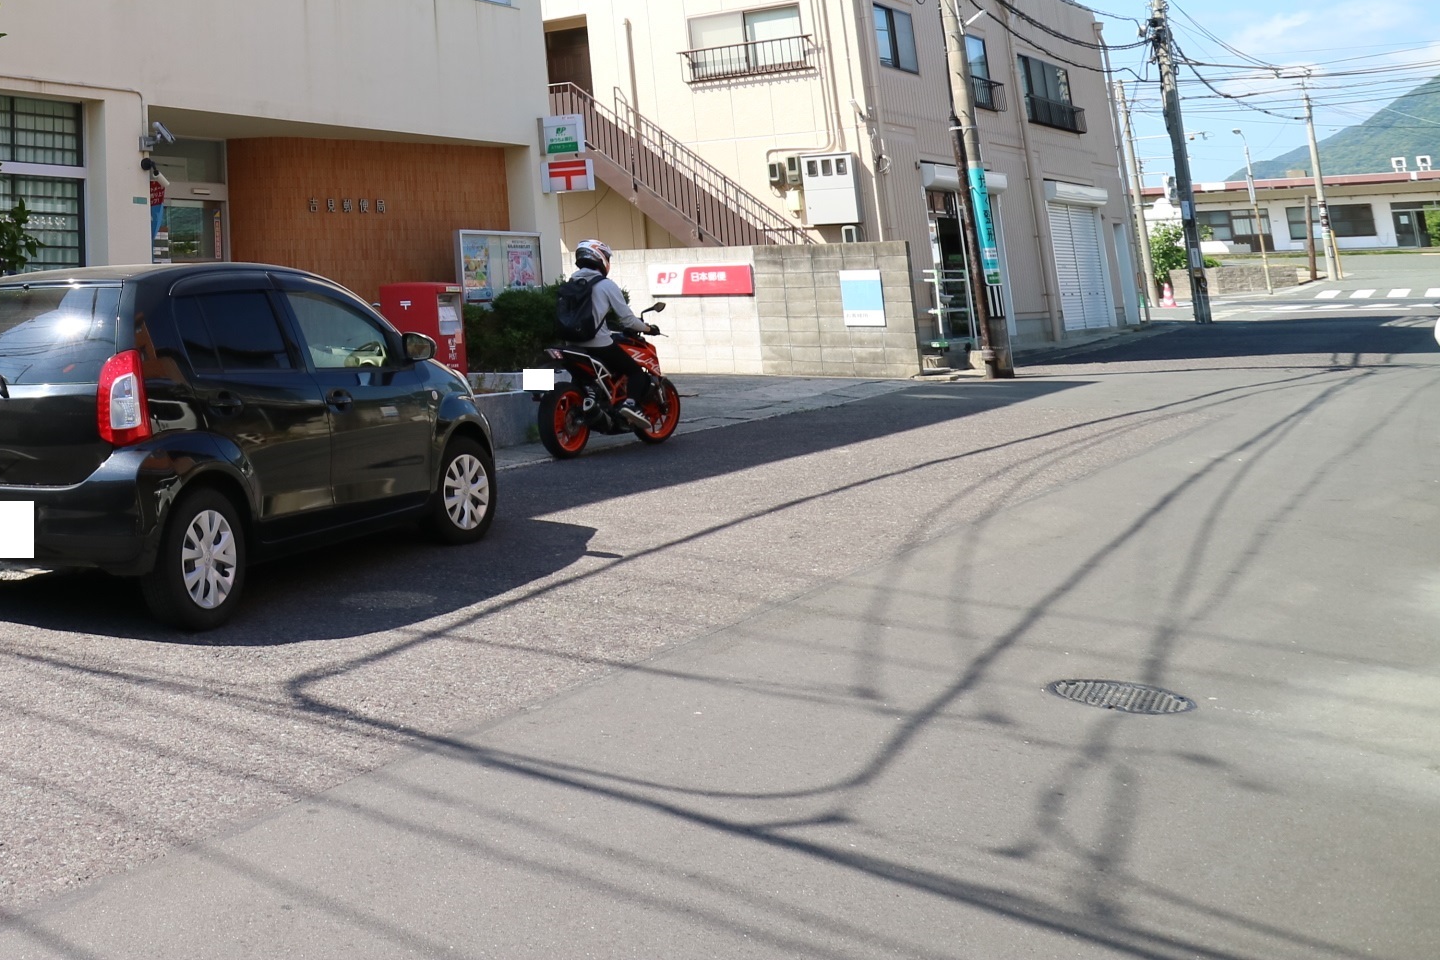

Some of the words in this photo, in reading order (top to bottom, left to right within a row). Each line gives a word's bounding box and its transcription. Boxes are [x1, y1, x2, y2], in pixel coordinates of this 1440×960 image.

[309, 197, 386, 214] 吉見郵便局
[657, 272, 678, 284] JP
[690, 271, 727, 282] 日本郵便
